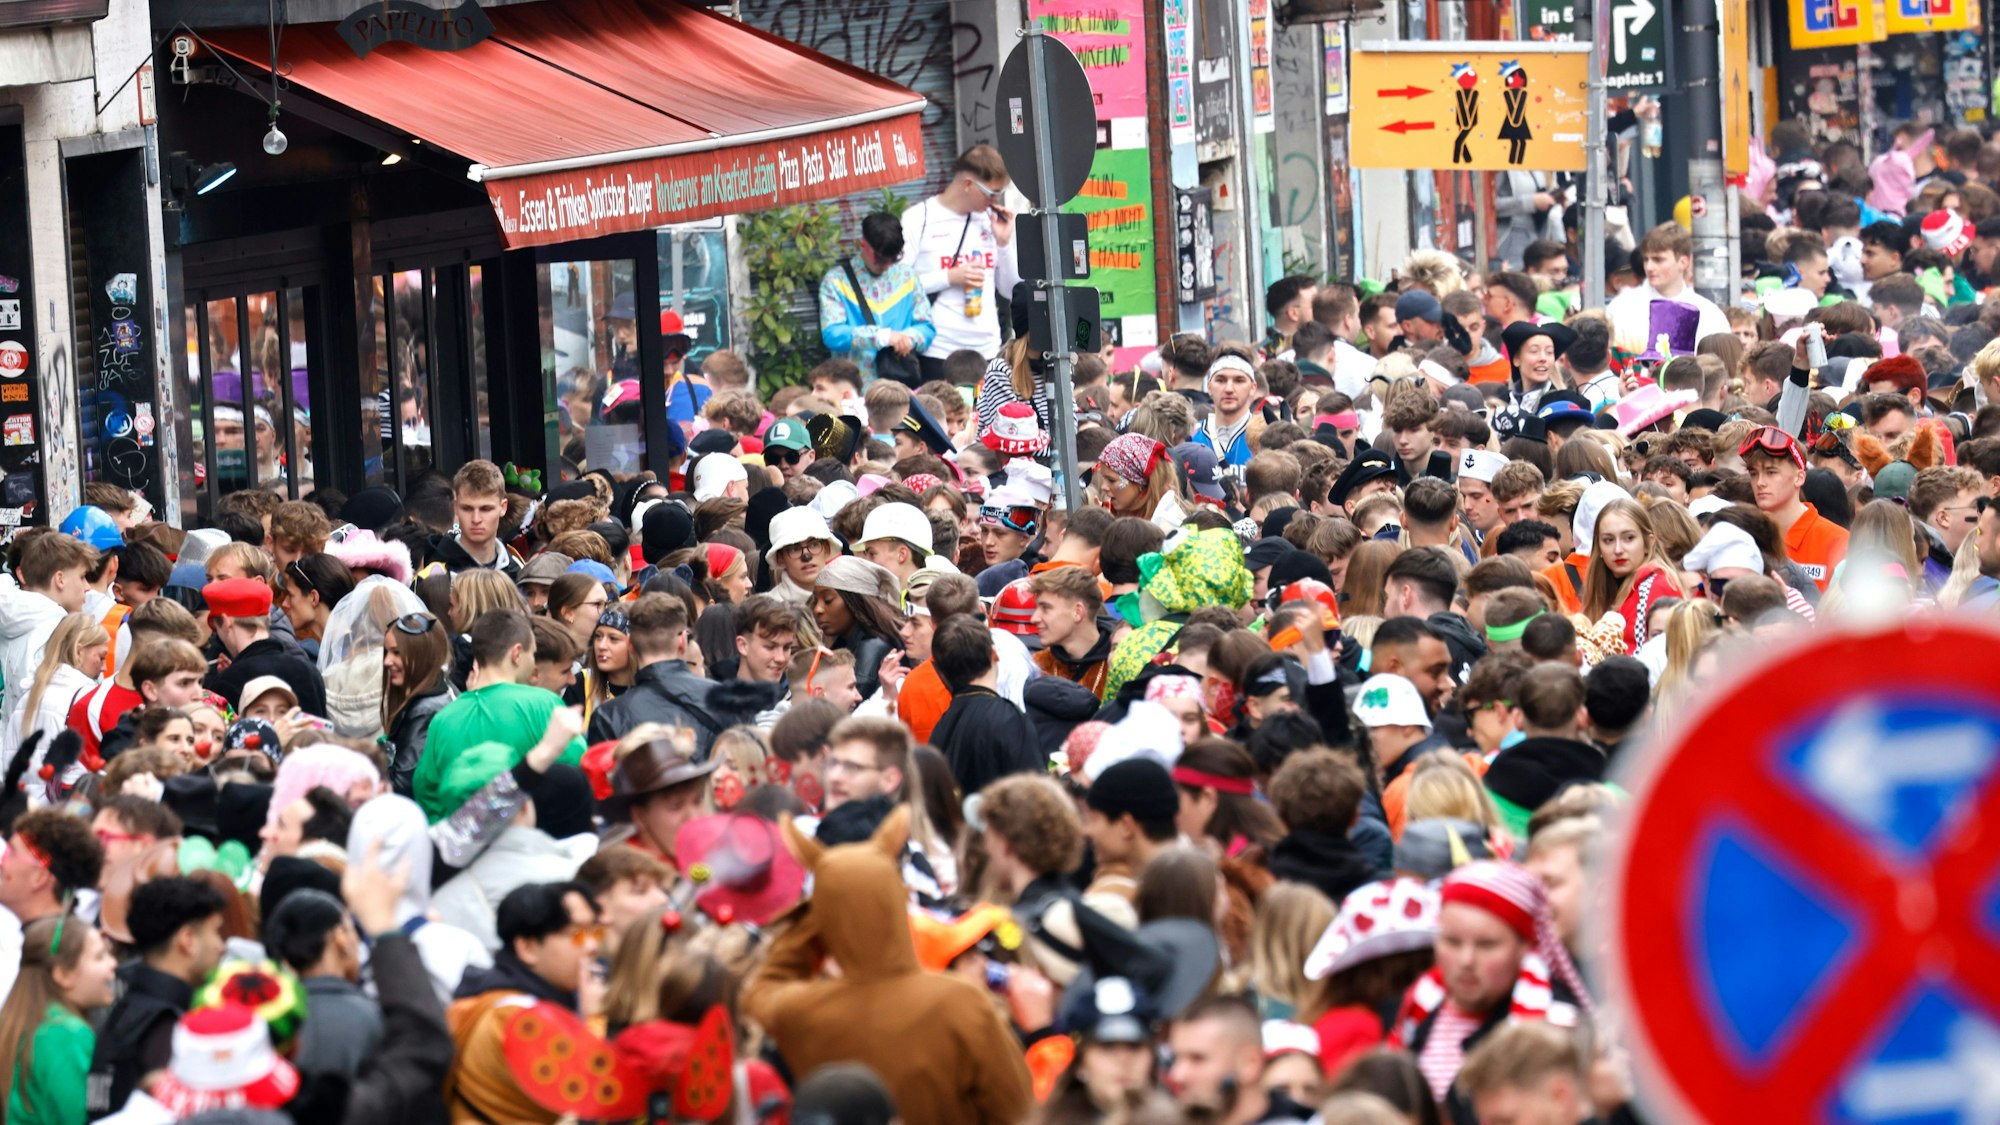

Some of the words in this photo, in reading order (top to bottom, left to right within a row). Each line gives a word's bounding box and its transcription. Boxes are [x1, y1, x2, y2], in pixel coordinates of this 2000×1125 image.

[354, 11, 474, 41] PAPELITO
[1047, 12, 1059, 34] IN
[1063, 10, 1084, 34] DER
[1087, 8, 1119, 33] HAND
[1541, 8, 1560, 24] in
[1654, 71, 1664, 84] 1
[519, 190, 547, 232] Essen
[546, 187, 558, 231] &
[555, 183, 591, 228] Trinken
[586, 173, 626, 230] Sportsbar
[626, 173, 653, 224] Burger
[700, 173, 714, 206] am
[777, 148, 800, 190] Pizza
[801, 145, 825, 186] Pasta
[826, 137, 848, 180] Salat
[851, 130, 886, 176] Cocktail
[1114, 206, 1143, 233] NICHT
[773, 425, 786, 438] L
